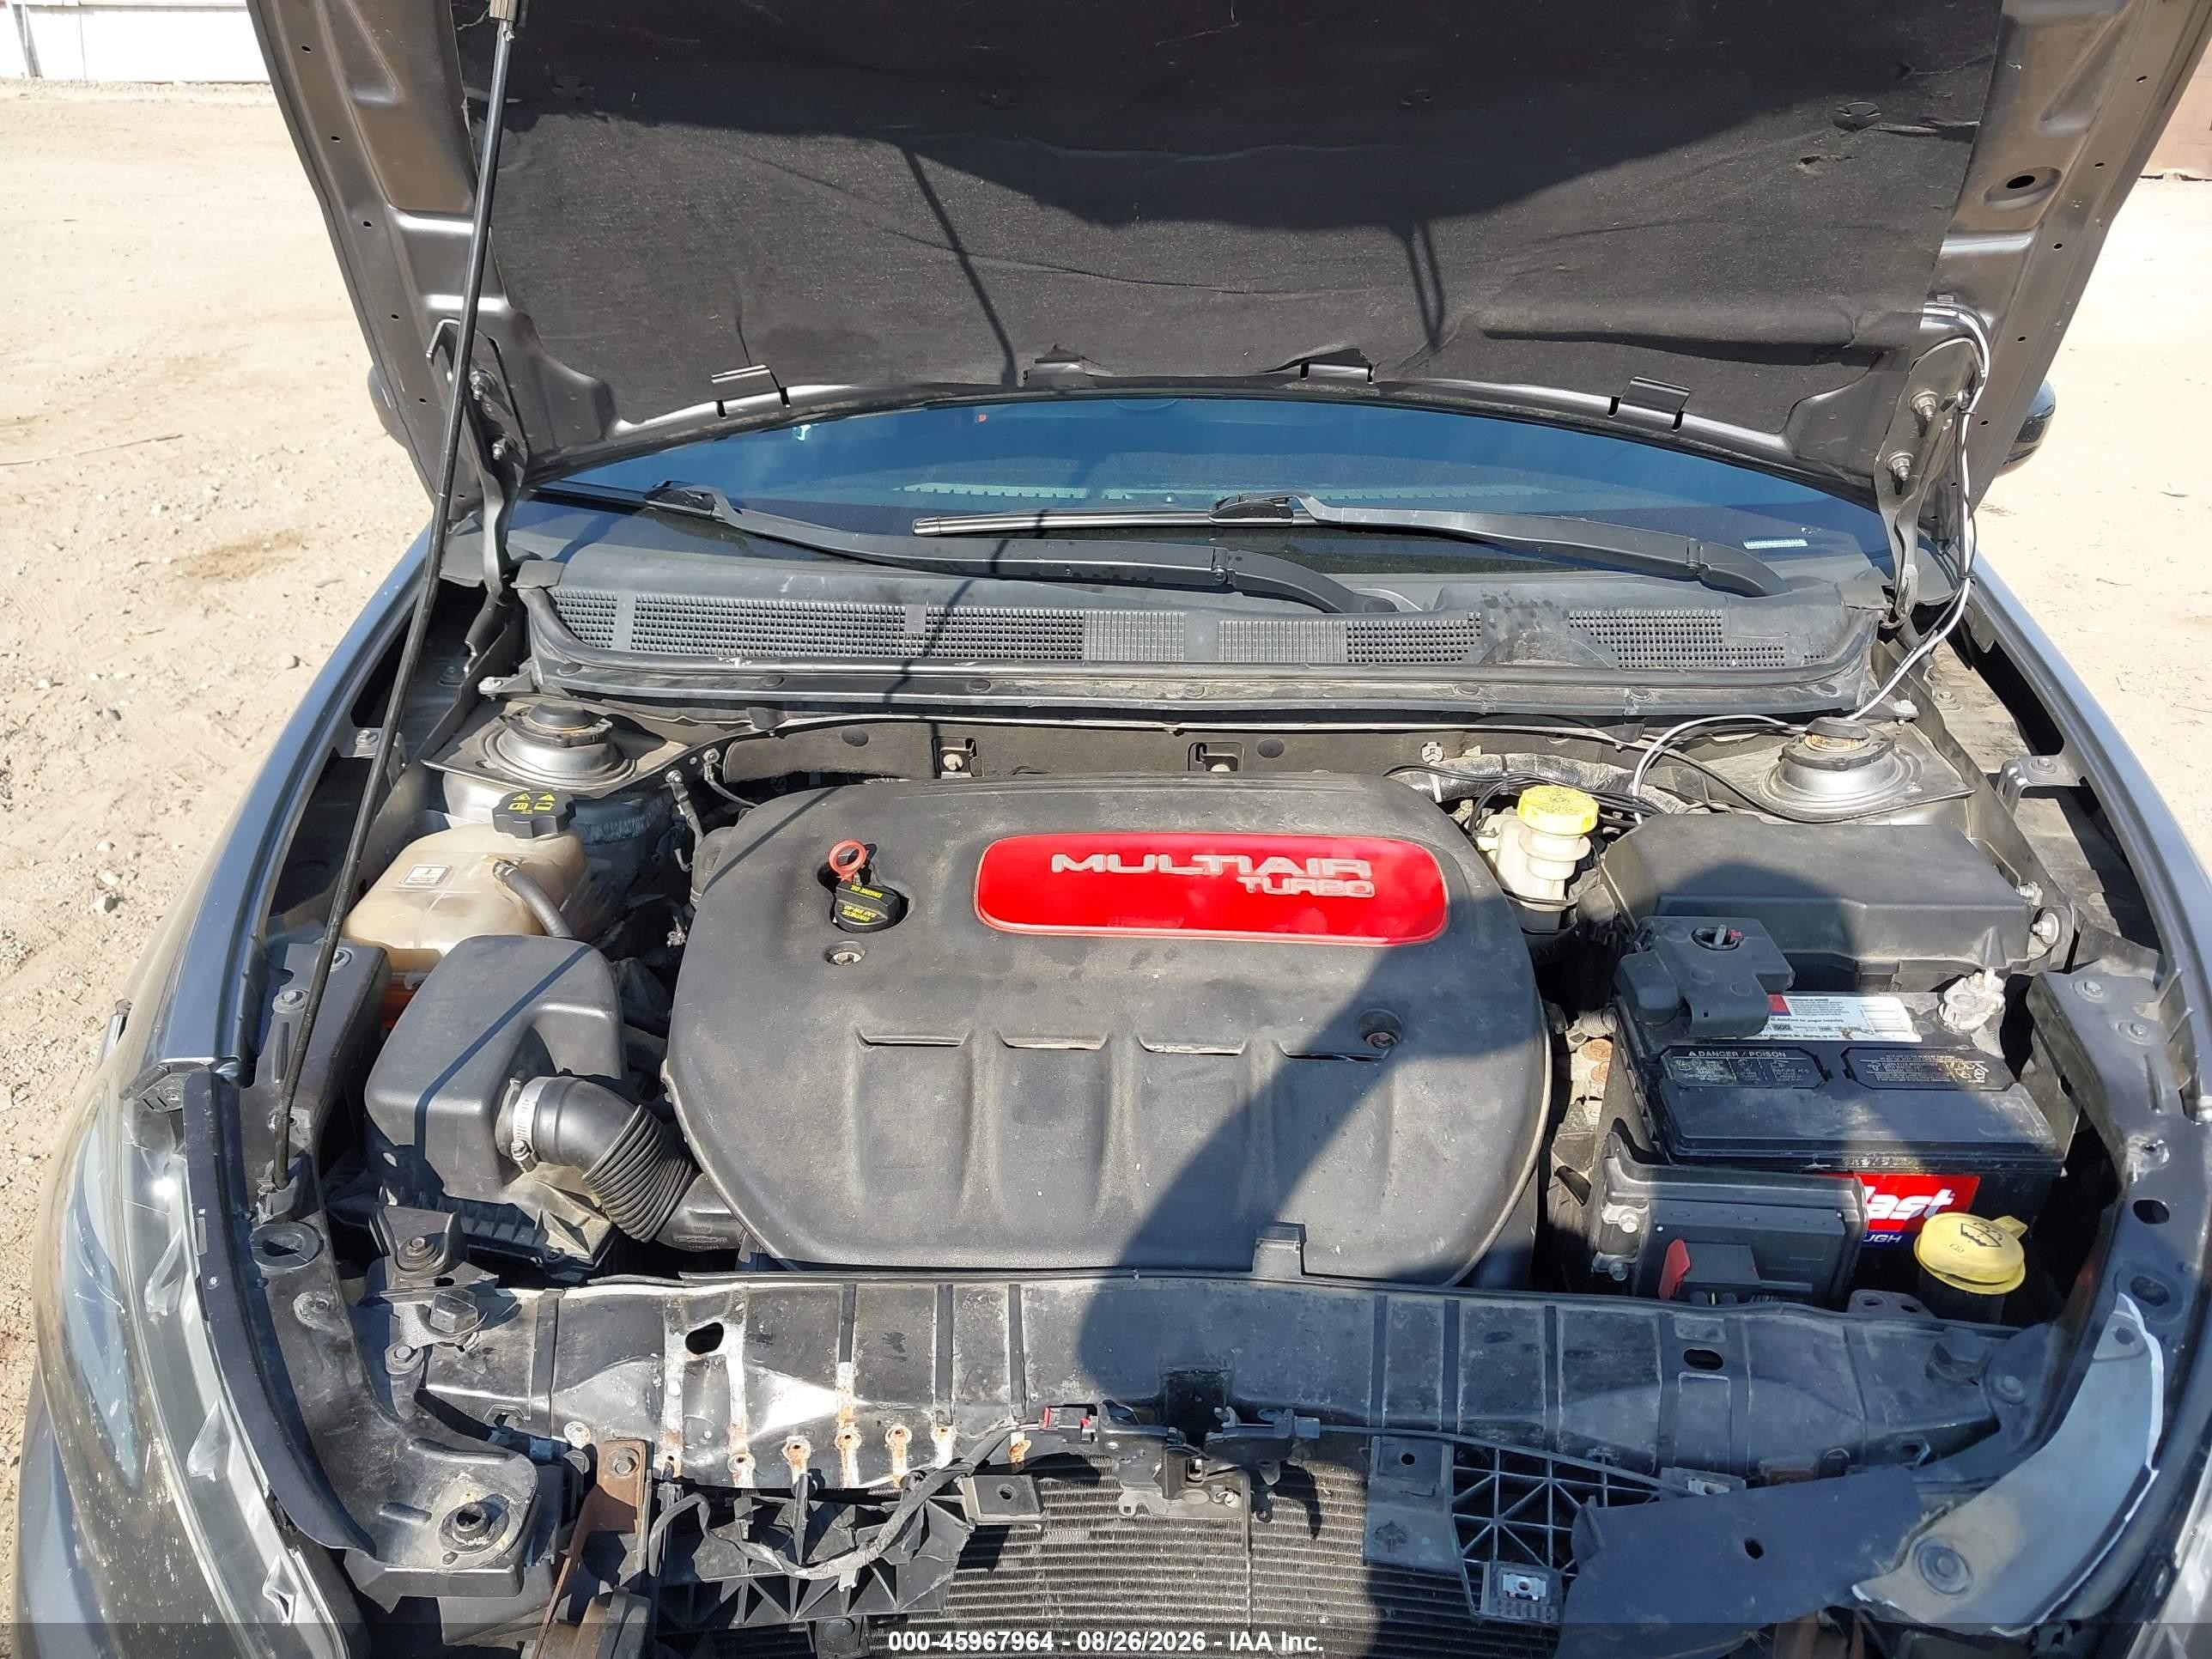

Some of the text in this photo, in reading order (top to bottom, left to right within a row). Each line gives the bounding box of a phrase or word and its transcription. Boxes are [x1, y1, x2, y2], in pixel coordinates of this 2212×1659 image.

[1049, 853, 1372, 879] MULTIAIR
[860, 888, 883, 898] ENGINE
[1237, 875, 1376, 898] TURBO
